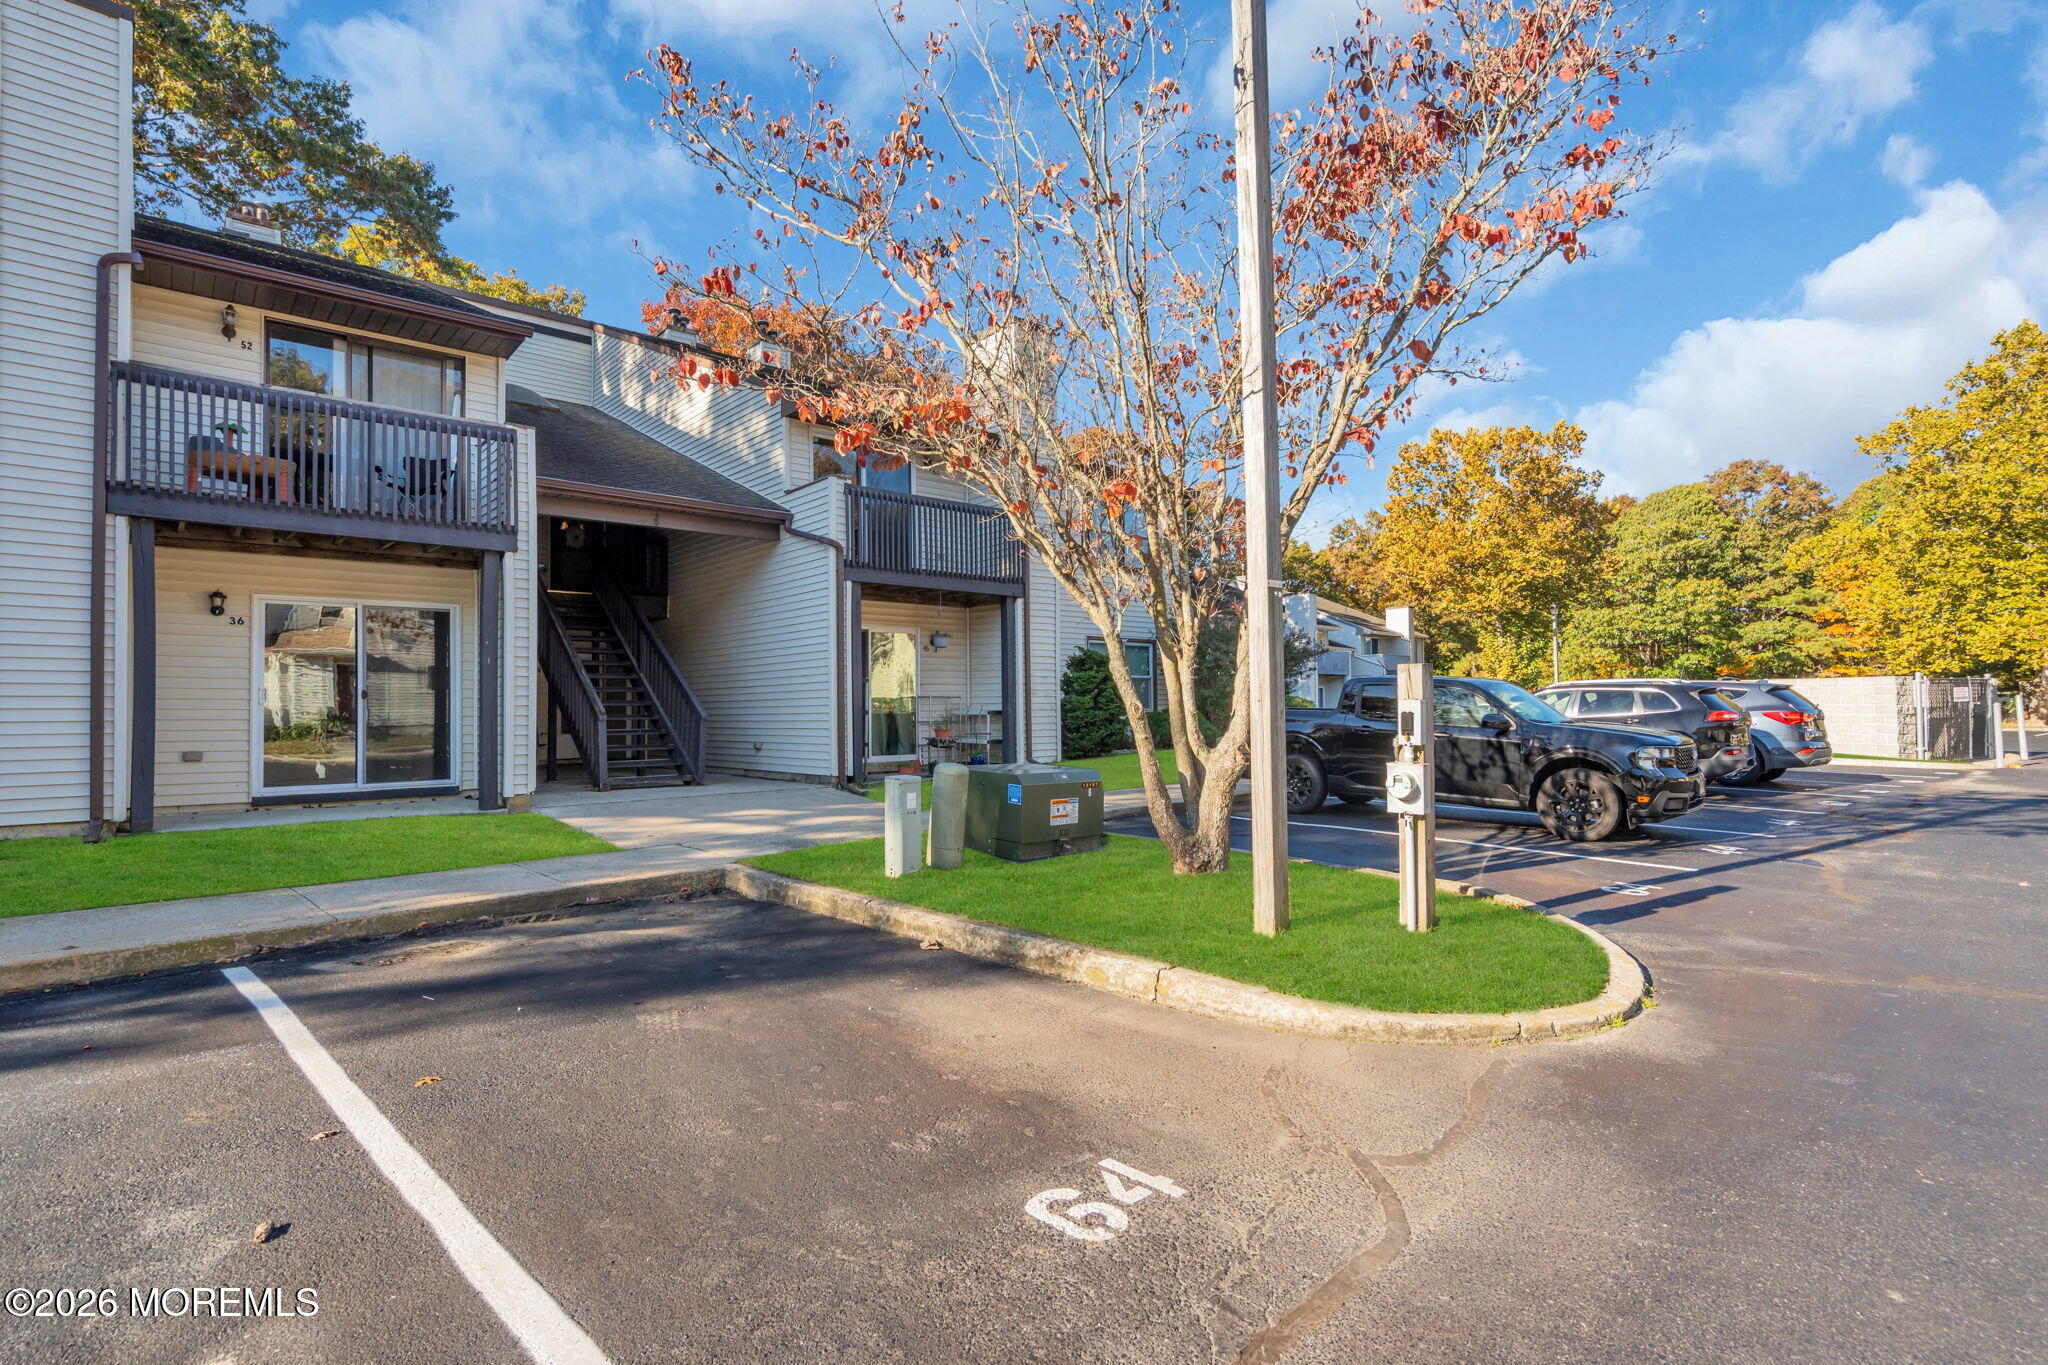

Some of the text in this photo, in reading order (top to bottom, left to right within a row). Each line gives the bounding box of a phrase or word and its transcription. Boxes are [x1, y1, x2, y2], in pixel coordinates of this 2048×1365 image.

[241, 340, 253, 351] 52
[229, 616, 245, 626] 36
[1024, 1157, 1189, 1242] 64
